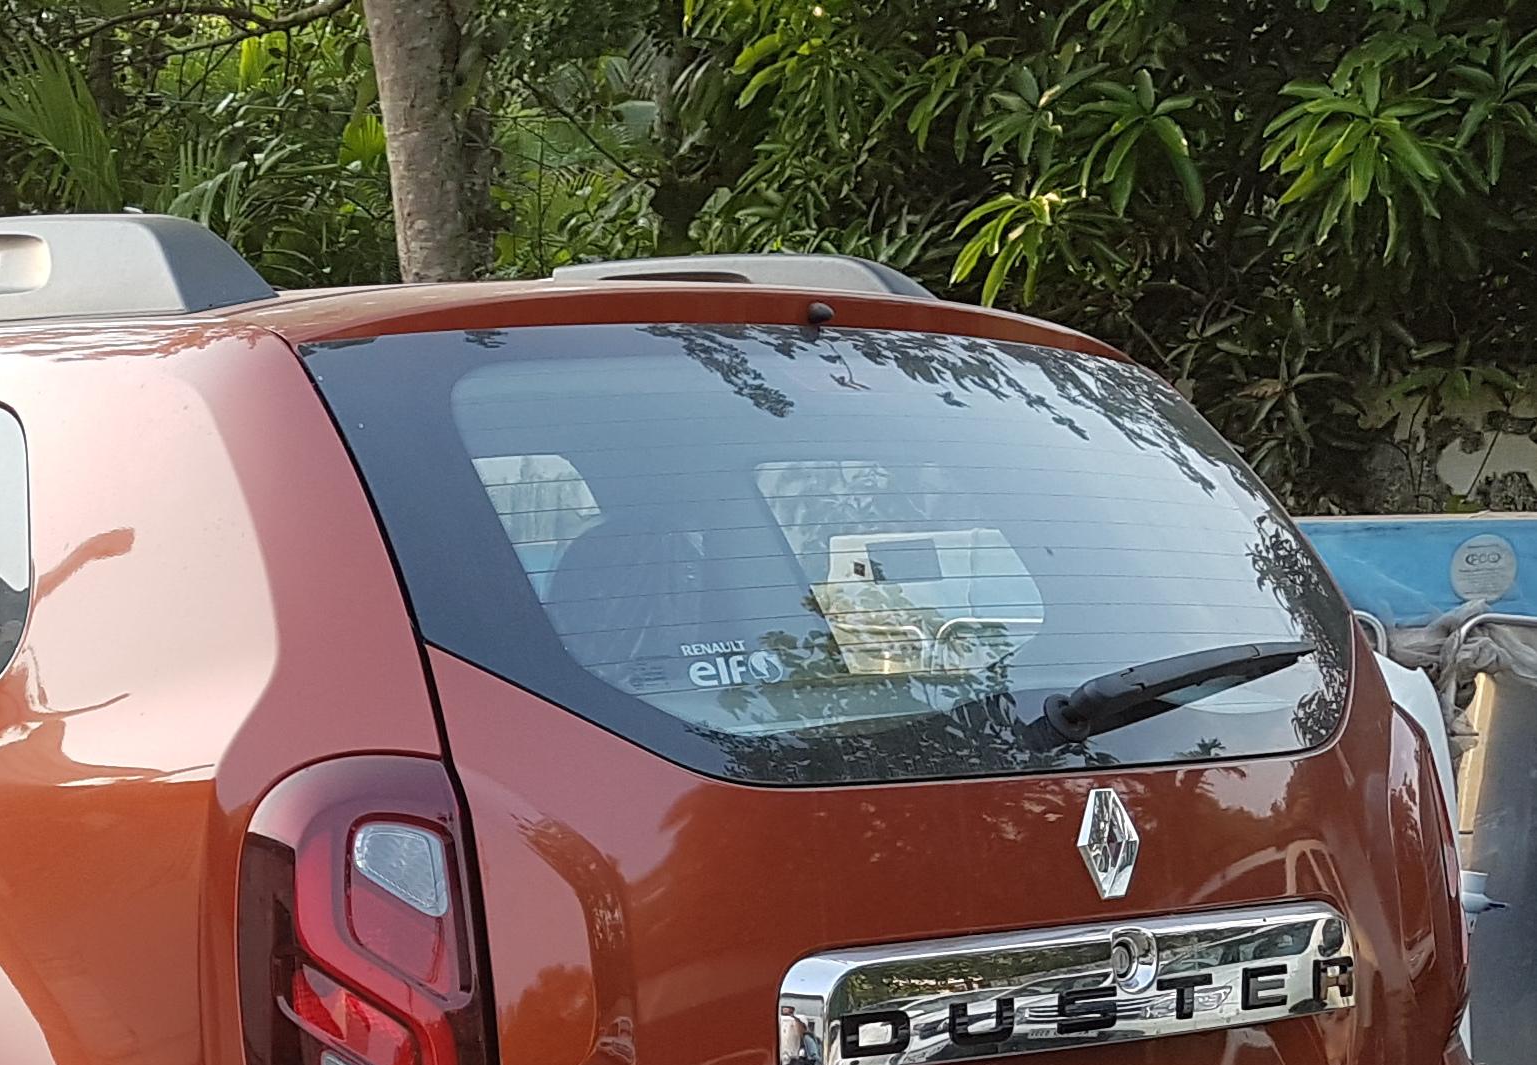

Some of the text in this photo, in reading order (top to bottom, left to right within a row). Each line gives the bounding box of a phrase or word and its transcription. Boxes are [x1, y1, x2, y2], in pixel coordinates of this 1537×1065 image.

[680, 639, 746, 657] RENAULT
[689, 655, 747, 687] elf
[840, 956, 1354, 1060] DUSTER
